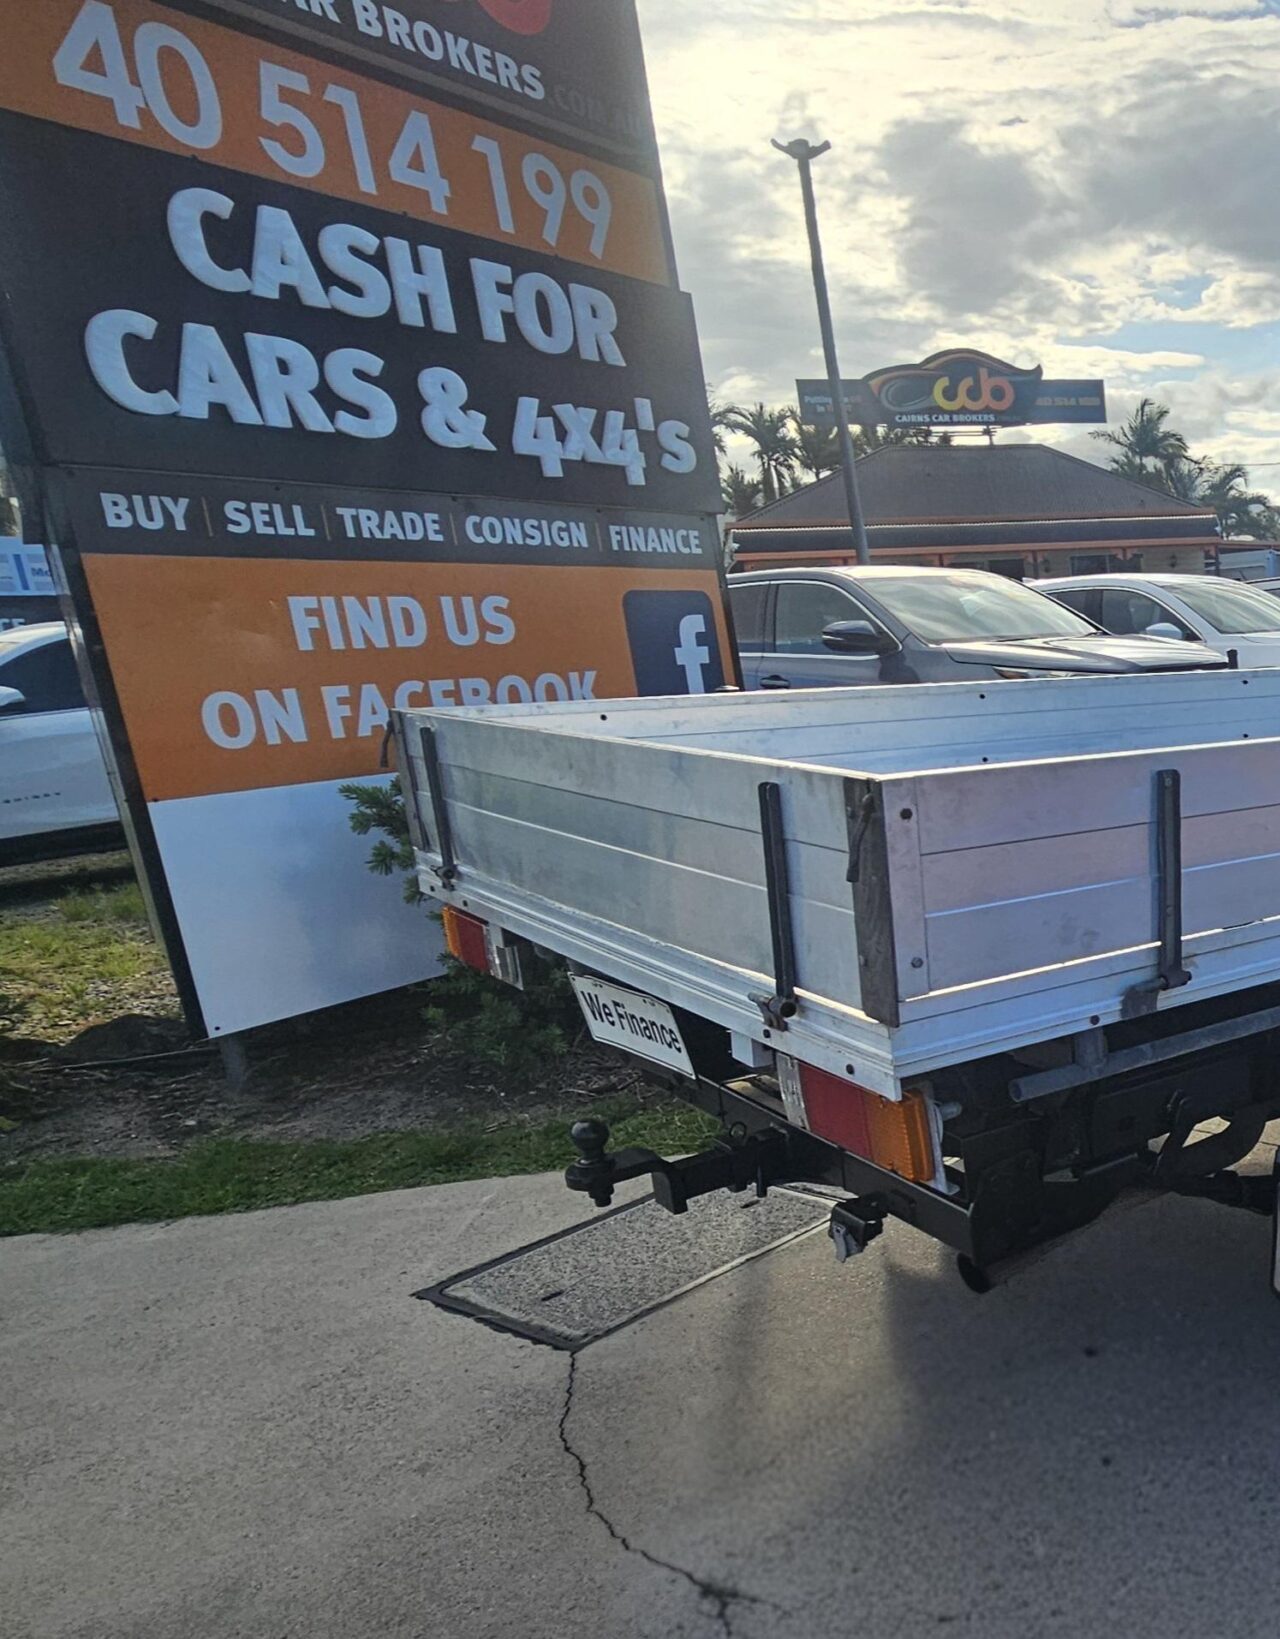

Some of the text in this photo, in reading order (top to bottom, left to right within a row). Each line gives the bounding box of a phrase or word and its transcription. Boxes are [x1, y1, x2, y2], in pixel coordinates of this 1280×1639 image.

[352, 0, 545, 100] BROKERS
[52, 0, 612, 260] 40 514 199
[167, 187, 626, 367] CASH FOR
[84, 309, 398, 439] CARS
[418, 367, 497, 451] &
[895, 414, 930, 422] CAIRNS
[932, 414, 950, 422] CAR
[952, 413, 995, 422] BROKERS
[100, 492, 703, 554] BUY SELL TRADE CONSIGN FINANCE
[287, 595, 516, 651] FIND US
[202, 688, 308, 749] ON
[581, 991, 682, 1053] We Finance
